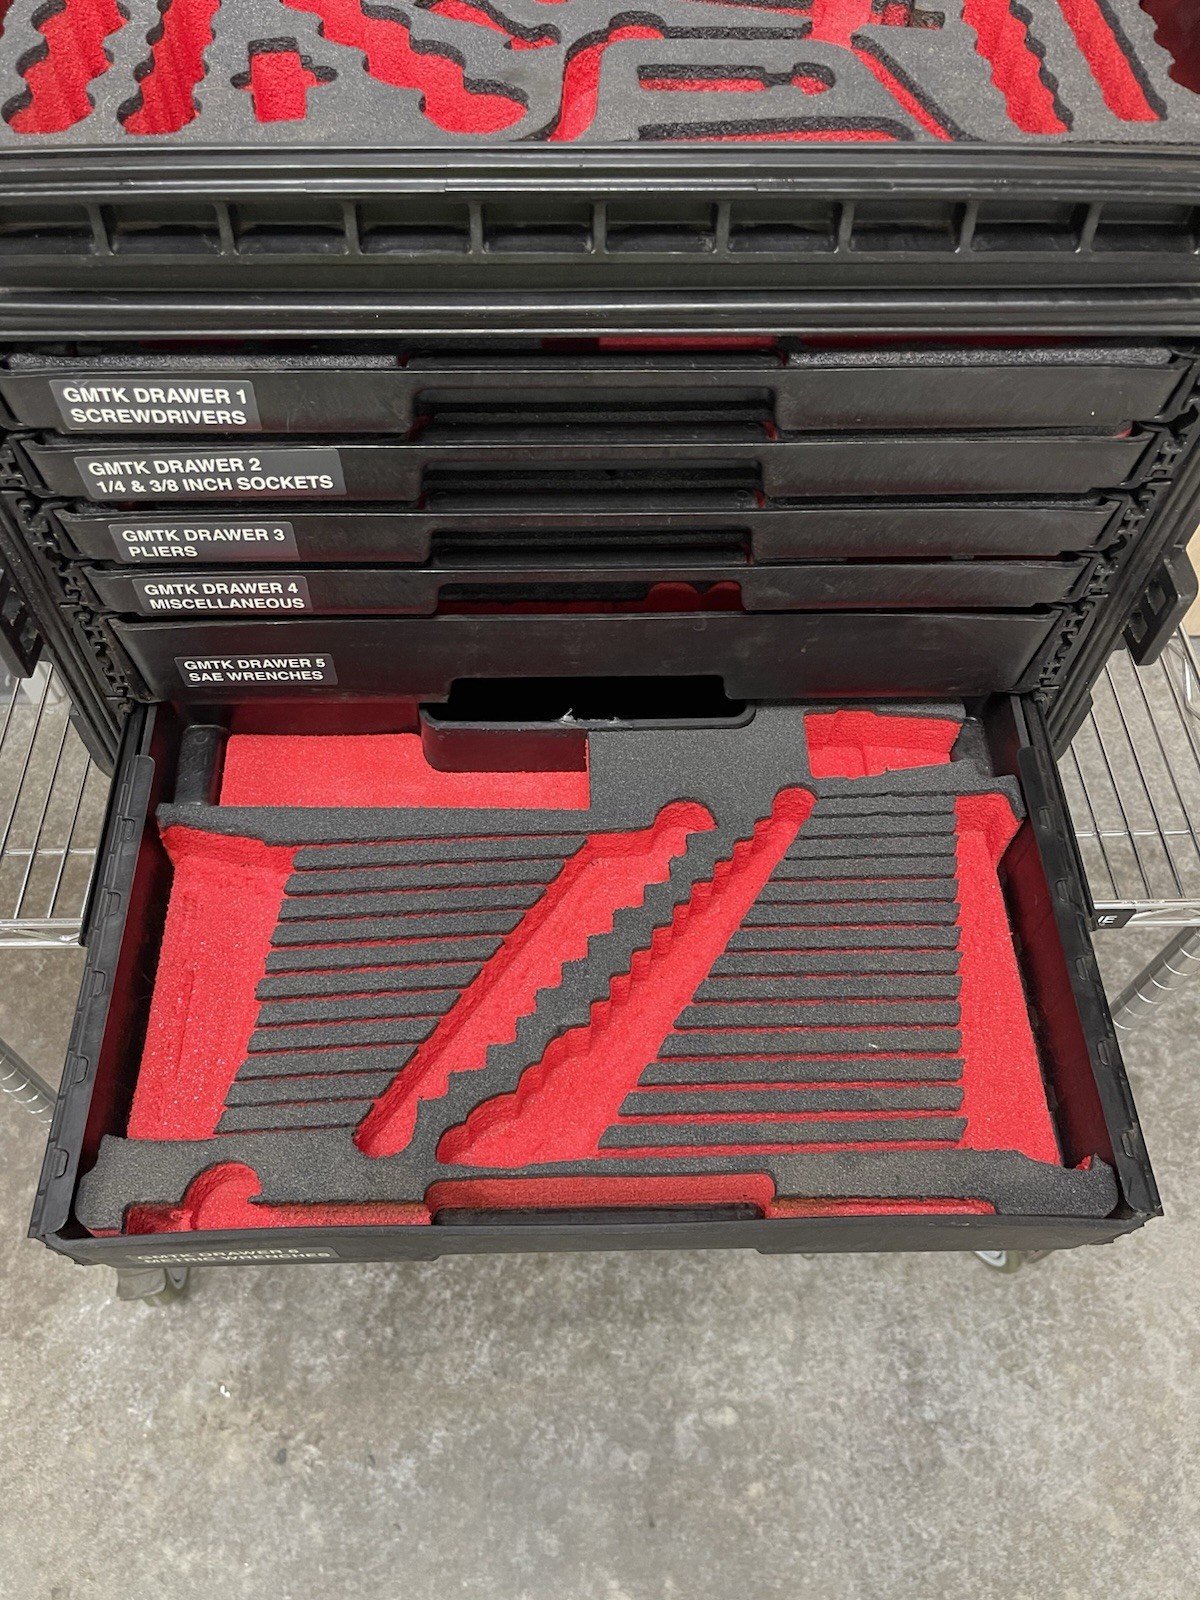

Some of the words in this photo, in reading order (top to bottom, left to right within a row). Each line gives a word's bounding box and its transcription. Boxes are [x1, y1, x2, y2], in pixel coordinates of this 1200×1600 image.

[62, 387, 131, 404] GMTK
[133, 388, 231, 404] DRAWER
[236, 389, 247, 405] 1
[71, 408, 247, 425] SCREWDRIVERS
[88, 461, 151, 476] GMTK
[153, 459, 245, 474] DRAWER
[248, 458, 262, 472] 2
[96, 480, 125, 494] 1/4
[131, 480, 147, 493] &
[150, 479, 179, 493] 3/8
[182, 477, 233, 492] INCH
[237, 475, 334, 491] SOCKETS
[122, 529, 180, 542] GMTK
[183, 529, 269, 541] DRAWER
[273, 528, 285, 541] 3
[128, 546, 198, 557] PLIERS
[143, 584, 199, 596] GMTK
[202, 583, 282, 595] DRAWER
[287, 582, 298, 594] 4
[149, 598, 305, 610] MISCELLANEOUS
[183, 660, 235, 670] GMTK
[237, 659, 312, 670] DRAWER
[315, 658, 325, 668] 5
[189, 671, 224, 682] SAE
[226, 670, 323, 681] WRENCHES
[198, 1249, 283, 1257] DRAWER
[219, 1252, 331, 1261] WRENCHES
